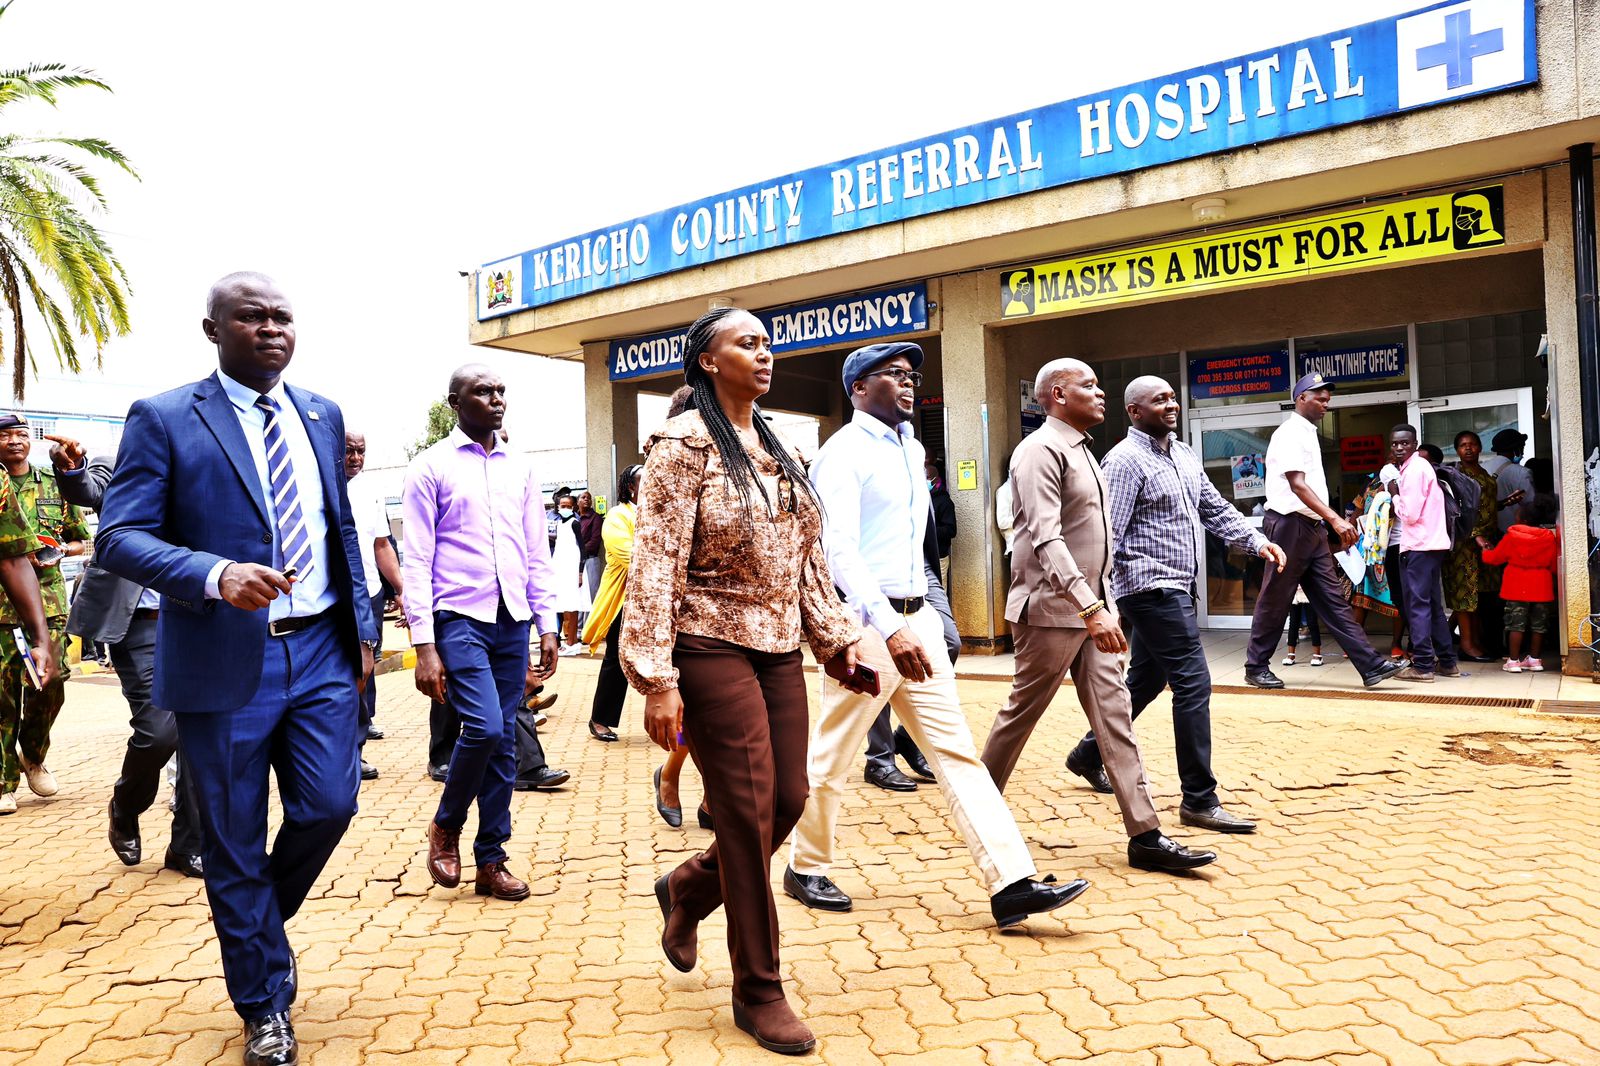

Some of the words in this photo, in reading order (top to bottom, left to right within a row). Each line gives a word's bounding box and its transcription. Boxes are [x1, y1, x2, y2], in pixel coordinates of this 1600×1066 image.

[533, 223, 650, 291] KERICHO
[671, 180, 804, 256] COUNTY
[831, 118, 1043, 216] REFERRAL
[1077, 36, 1365, 158] HOSPITAL
[1037, 261, 1118, 304] MASK
[1127, 257, 1156, 291] IS
[1165, 253, 1186, 284] A
[1193, 234, 1284, 280] MUST
[1294, 221, 1368, 265] FOR
[1380, 207, 1450, 251] ALL
[771, 291, 916, 346] EMERGENCY
[1206, 357, 1242, 370] EMERGENCY
[1234, 370, 1243, 380] OR
[1244, 369, 1257, 379] 0717
[1258, 368, 1270, 377] 714
[1305, 351, 1367, 378] CASUALTY/NHIF
[1369, 348, 1399, 373] OFFICE
